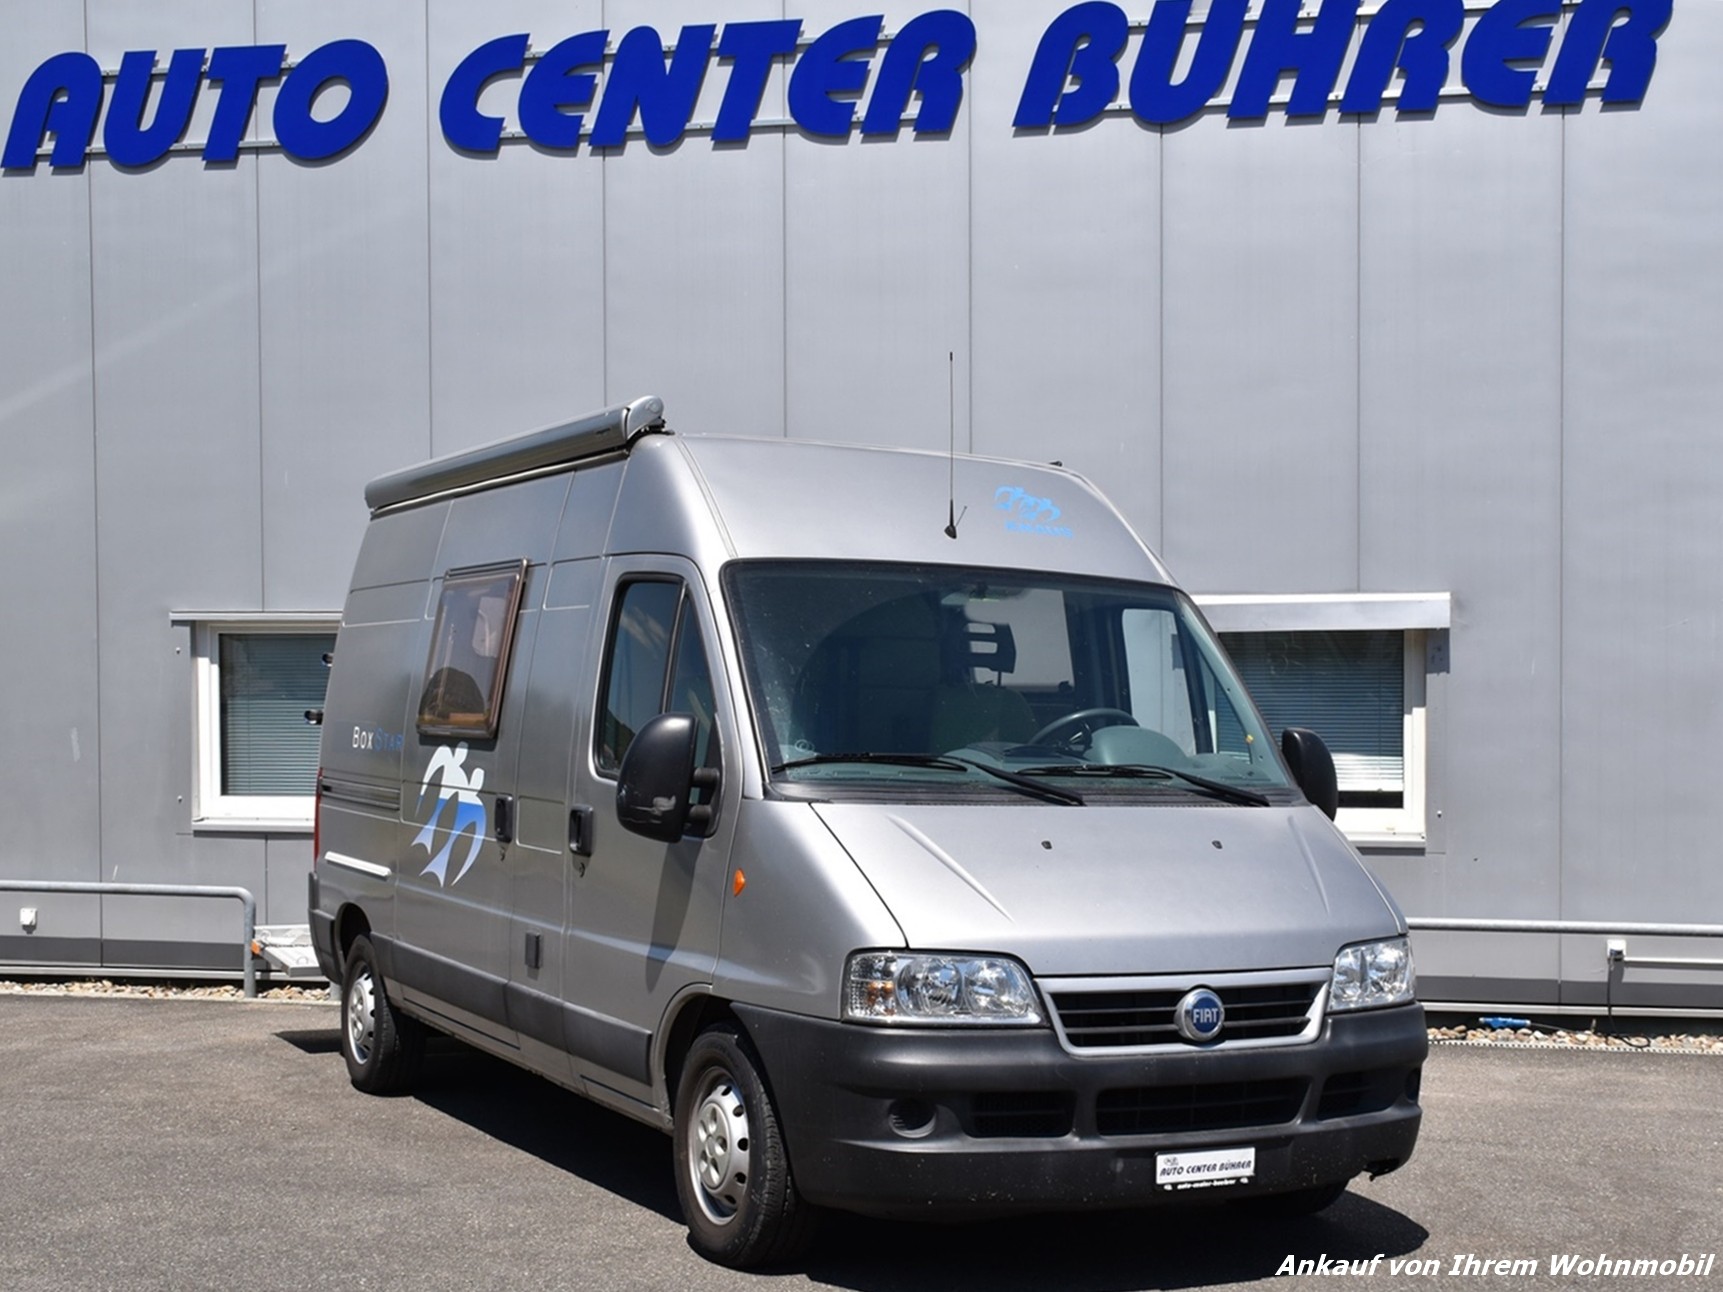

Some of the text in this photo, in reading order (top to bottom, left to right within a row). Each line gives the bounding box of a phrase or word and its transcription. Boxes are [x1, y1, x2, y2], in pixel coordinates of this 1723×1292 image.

[1, 39, 388, 168] AUTO
[440, 10, 977, 150] CENTER
[1193, 1008, 1219, 1023] FIAT
[1160, 1166, 1184, 1176] AUTO
[1186, 1163, 1217, 1174] CENTER
